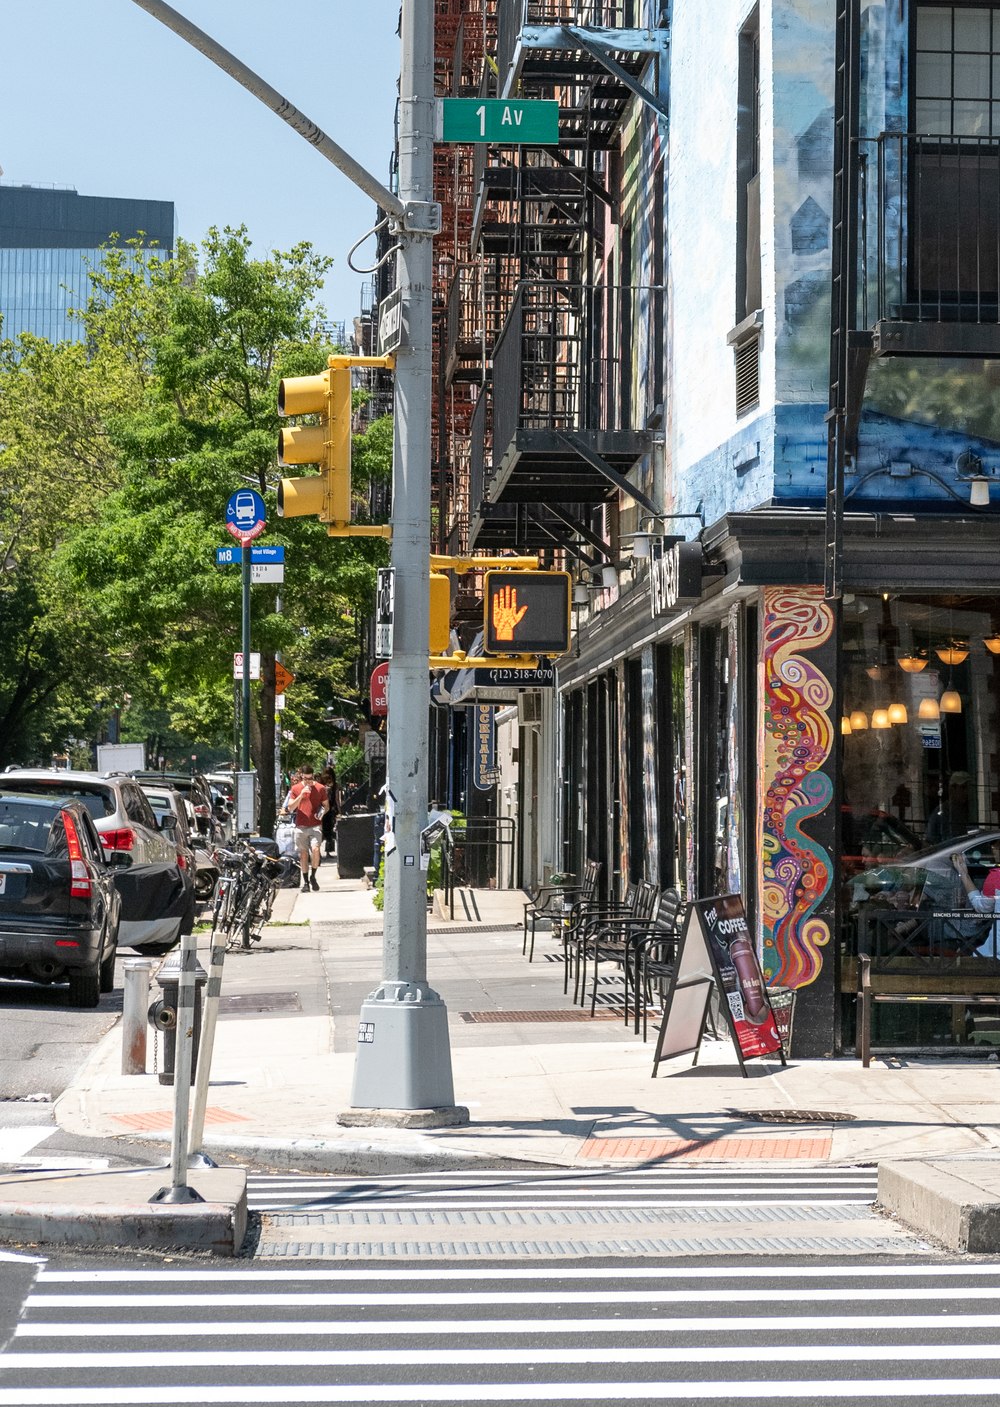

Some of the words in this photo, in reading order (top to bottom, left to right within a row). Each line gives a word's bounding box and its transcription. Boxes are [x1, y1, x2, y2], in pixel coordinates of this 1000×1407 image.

[476, 105, 486, 137] 1
[501, 107, 523, 126] Av
[218, 549, 232, 562] M8
[514, 669, 553, 679] 518-7070
[479, 704, 490, 785] OCKTAILS
[704, 907, 718, 927] Free
[718, 917, 748, 935] COFFEE
